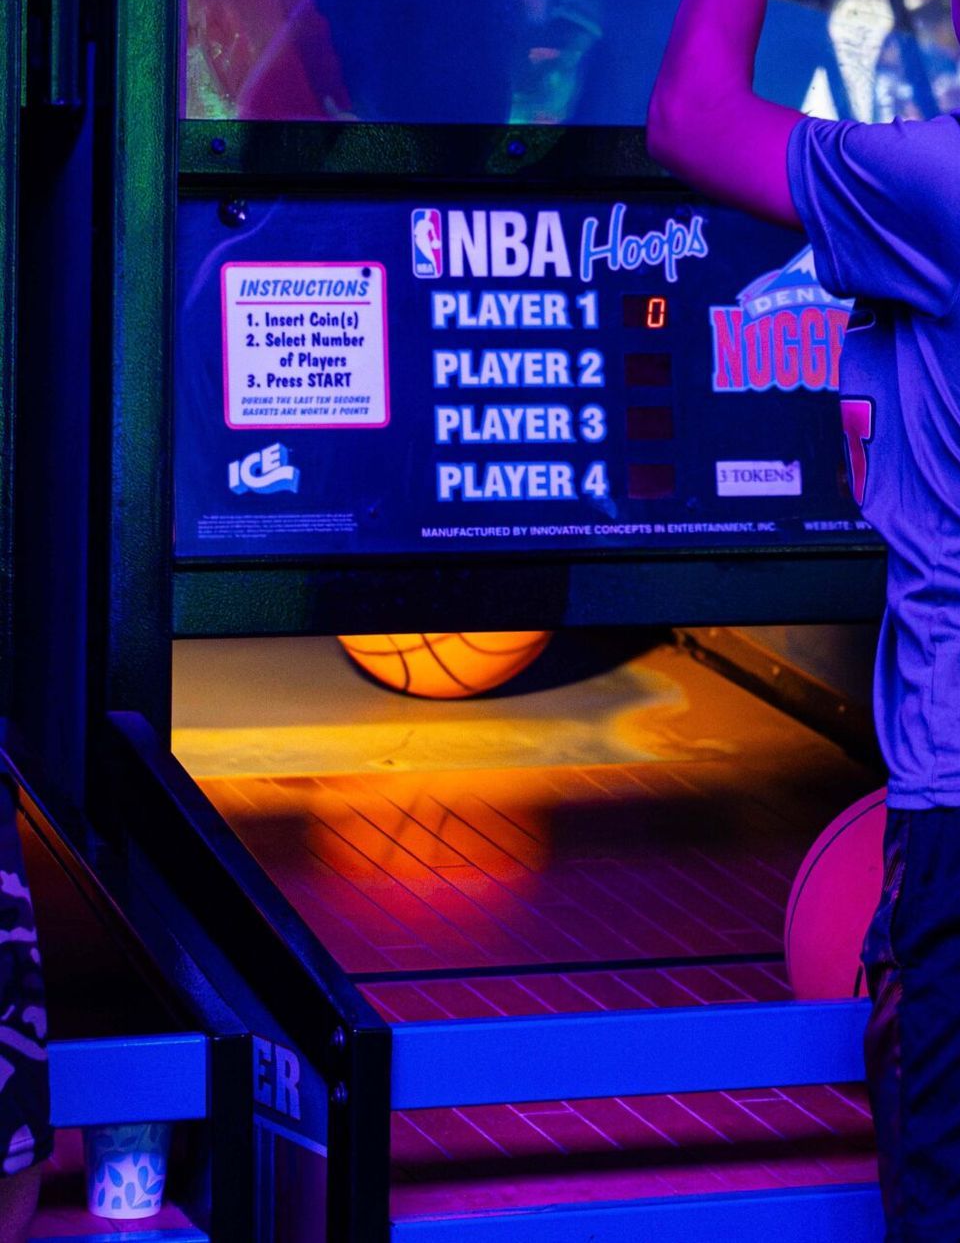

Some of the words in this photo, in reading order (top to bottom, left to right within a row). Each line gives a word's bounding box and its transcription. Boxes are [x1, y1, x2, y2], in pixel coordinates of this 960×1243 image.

[448, 210, 572, 278] NBA
[580, 203, 708, 283] Hoops
[239, 279, 370, 297] INSTRUCTIONS
[433, 291, 571, 329] PLAYER
[576, 291, 599, 329] 1
[647, 298, 665, 328] 0
[246, 312, 259, 327] 1.
[265, 312, 304, 327] Insert
[309, 311, 359, 330] Coin(s)
[246, 333, 260, 347] 2.
[265, 332, 306, 347] Select
[311, 331, 365, 347] Number
[280, 352, 294, 367] of
[298, 352, 347, 371] Players
[434, 349, 573, 388] PLAYER
[577, 349, 605, 388] 2
[247, 374, 261, 388] 3.
[267, 373, 303, 388] Press
[307, 372, 352, 388] START
[293, 396, 314, 404] LAST
[280, 407, 297, 416] ARE
[435, 404, 575, 444] PLAYER
[580, 403, 607, 443] 3
[228, 442, 299, 495] ICE
[732, 469, 794, 483] TOKENS
[437, 461, 578, 501] PLAYER
[581, 460, 609, 499] 4
[421, 526, 510, 537] MANUFACTURED
[512, 527, 527, 536] BY
[530, 525, 592, 536] INNOVATIVE
[594, 524, 652, 535] CONCEPTS
[654, 524, 665, 533] IN
[252, 1035, 301, 1121] ER
